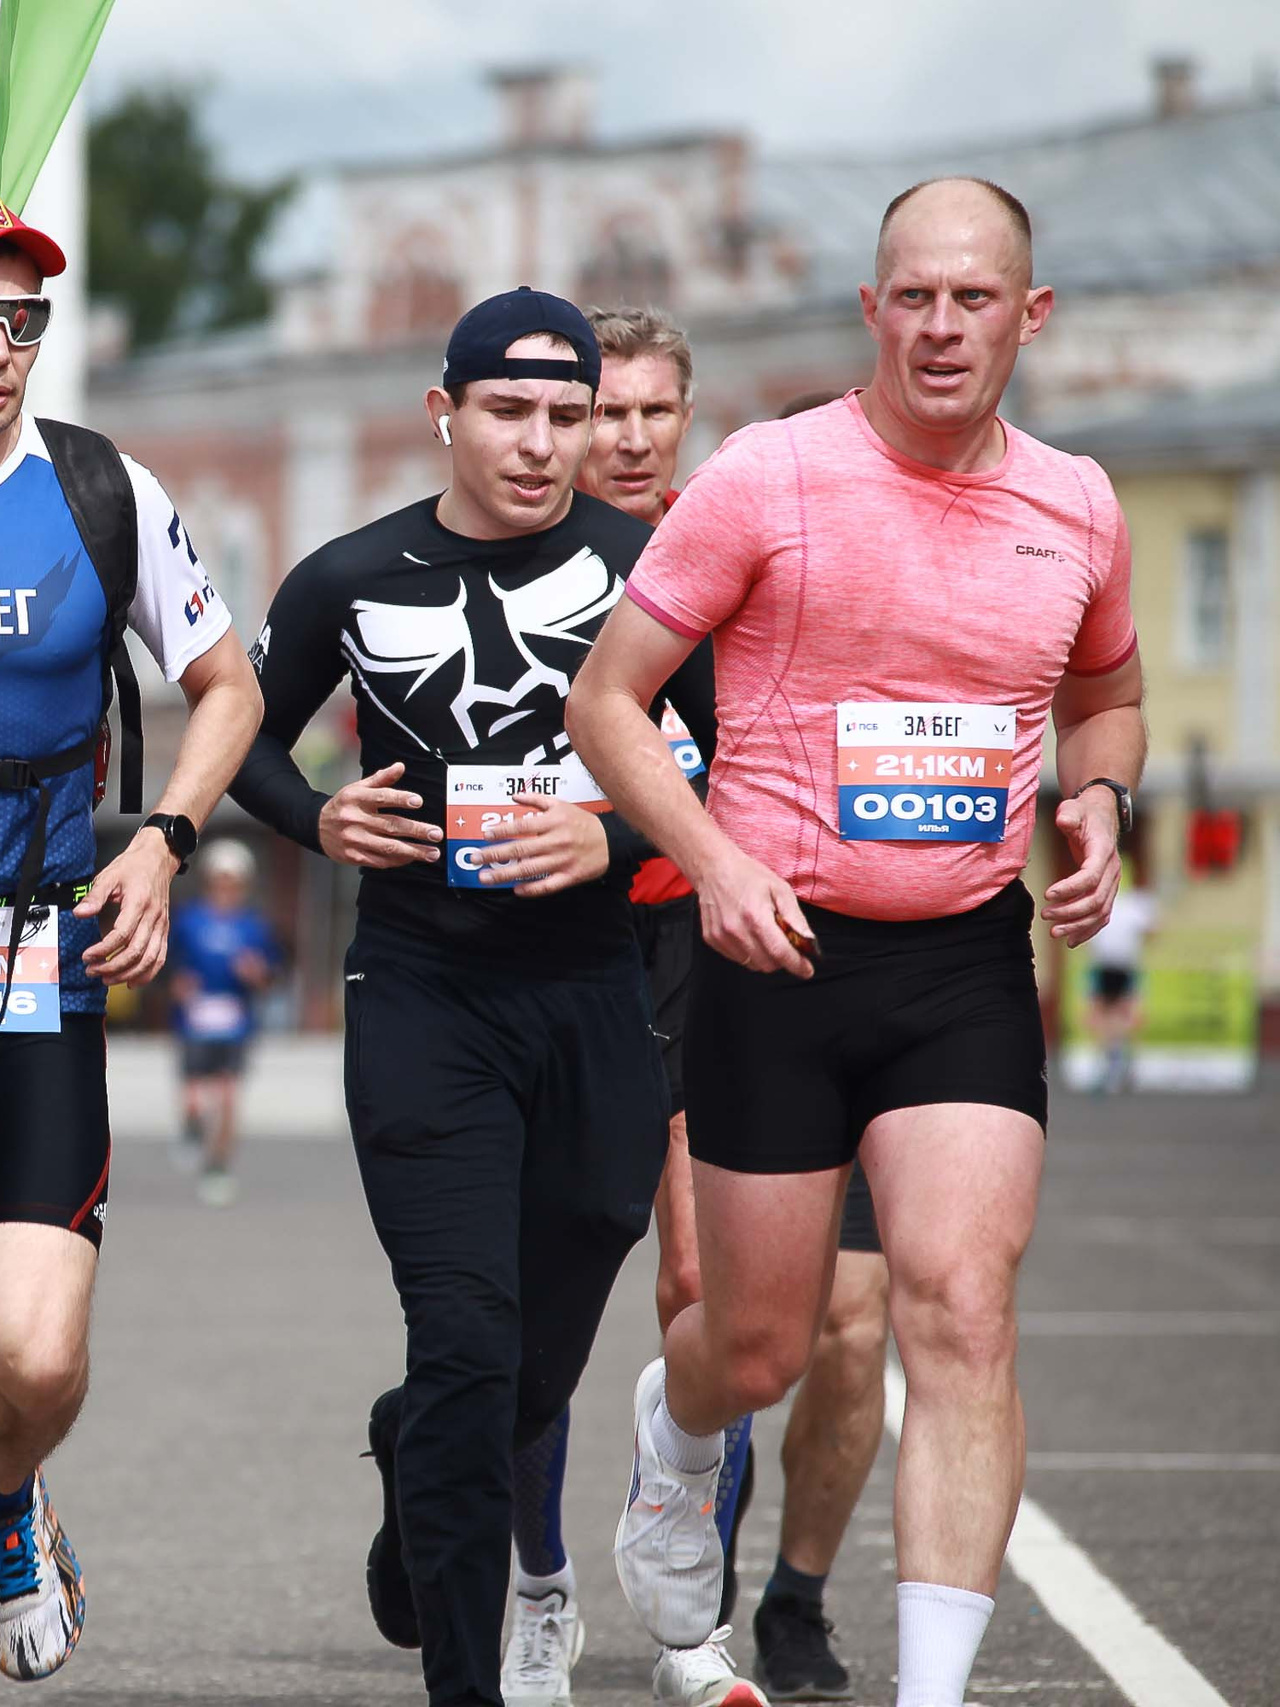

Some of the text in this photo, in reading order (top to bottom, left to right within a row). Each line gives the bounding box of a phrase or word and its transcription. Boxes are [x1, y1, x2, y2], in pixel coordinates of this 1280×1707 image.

[1016, 545, 1056, 560] CRAFT
[858, 723, 878, 731] ПСБ
[466, 783, 483, 791] ПСБ
[853, 793, 997, 822] 00103
[918, 824, 949, 833] ИЛЬЯ
